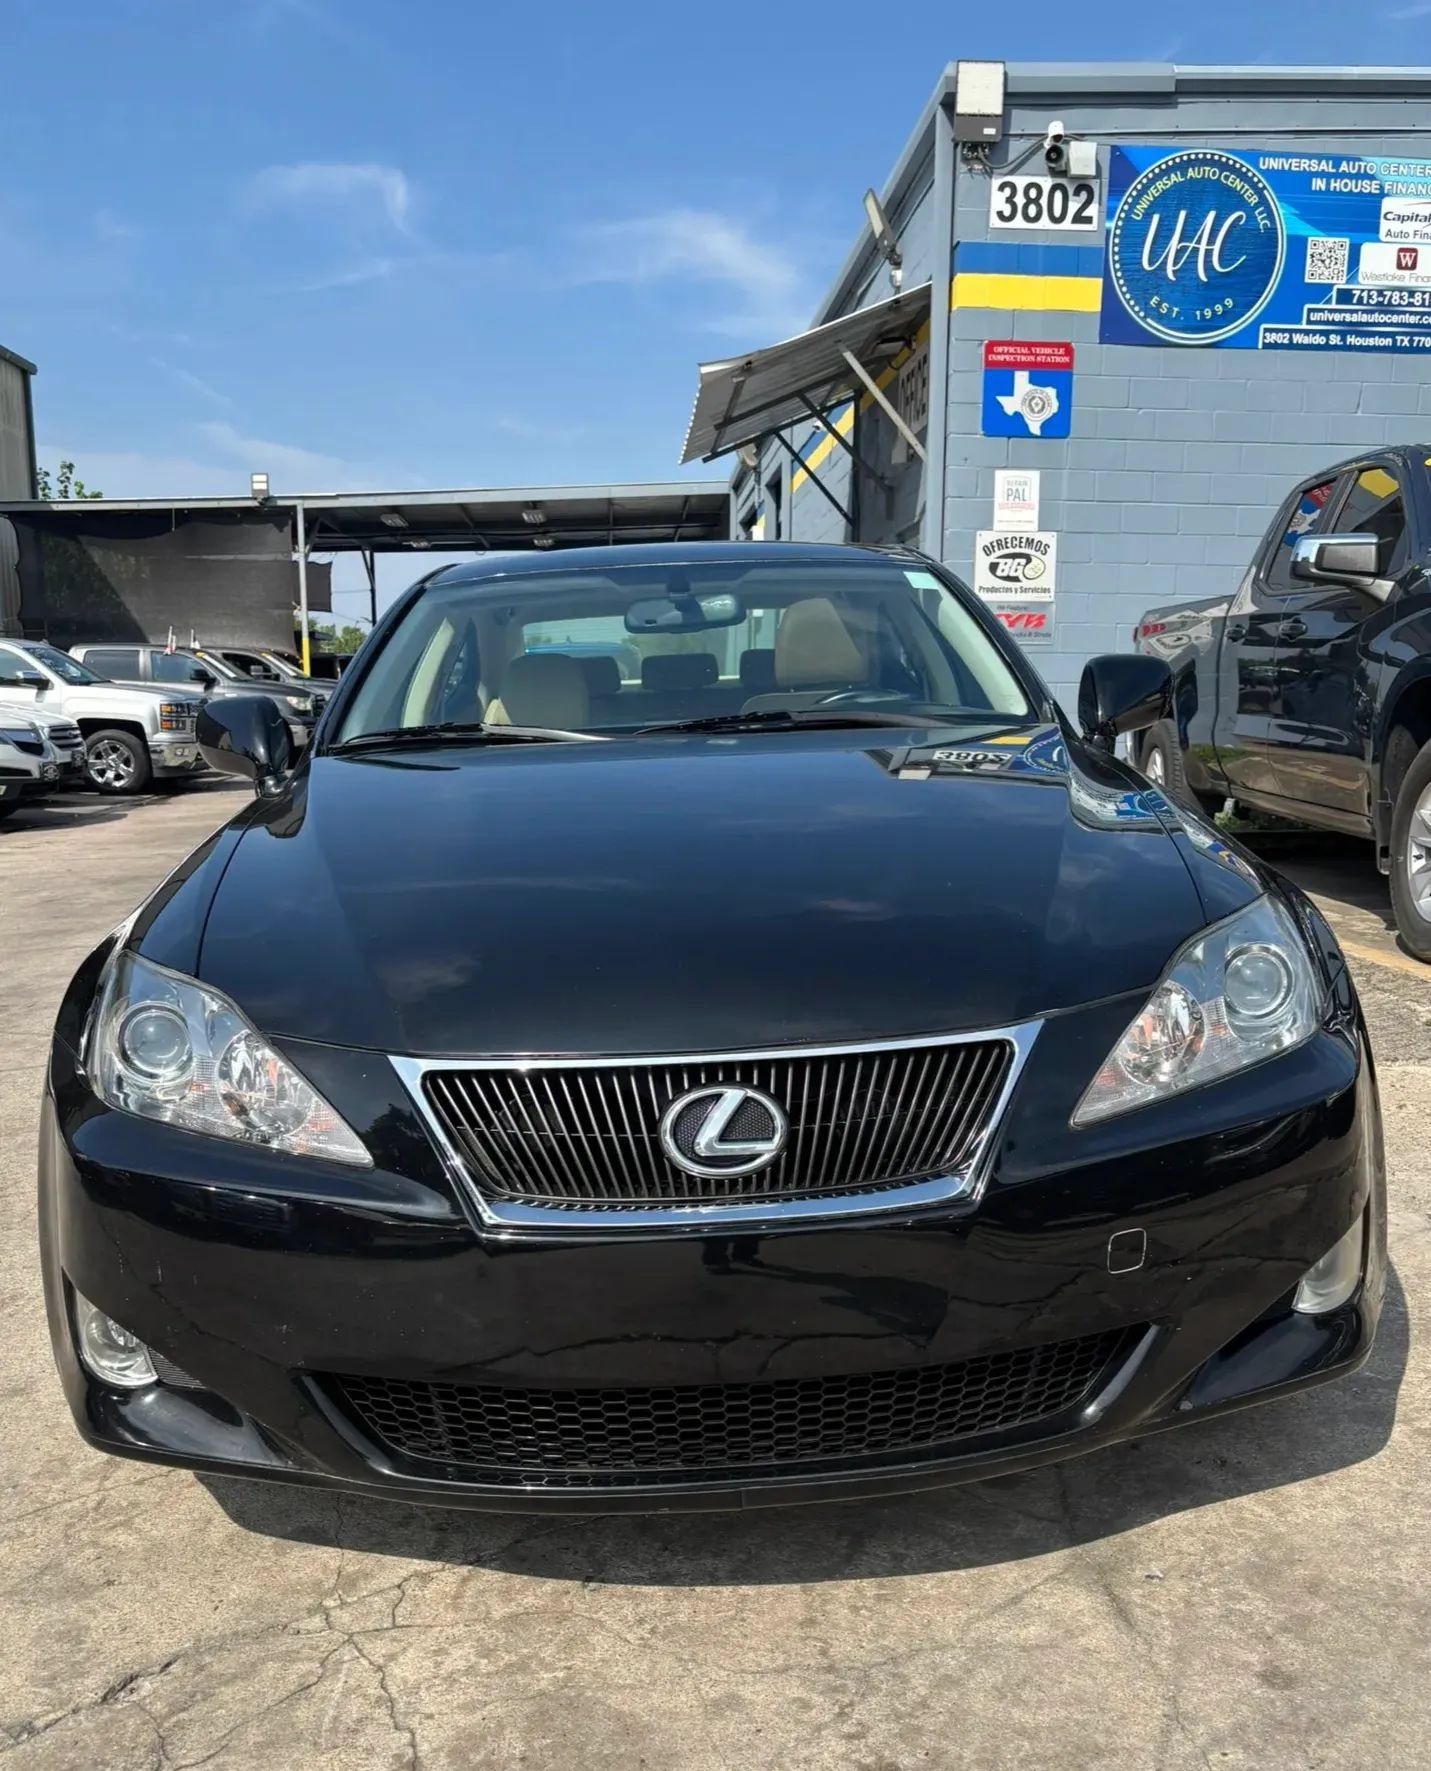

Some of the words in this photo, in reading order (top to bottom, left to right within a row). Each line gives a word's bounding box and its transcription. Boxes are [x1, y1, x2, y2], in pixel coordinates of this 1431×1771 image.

[1259, 156, 1336, 173] UNIVERSAL
[1339, 161, 1376, 175] AUTO
[1131, 171, 1185, 221] UNIVERSAL
[1187, 167, 1219, 180] AUTO
[1220, 171, 1259, 206] CENTER
[1312, 178, 1326, 191] IN
[1330, 179, 1380, 194] HOUSE
[996, 181, 1095, 225] 3802
[1385, 229, 1410, 239] Auto
[1142, 210, 1246, 282] UAC
[1361, 272, 1406, 282] Westlake
[1150, 296, 1184, 320] EST.
[1195, 298, 1233, 320] 1999
[1264, 332, 1289, 344] 3802
[1292, 334, 1326, 345] Waldo
[1329, 334, 1343, 345] St.
[1347, 335, 1392, 347] Houston
[1395, 336, 1410, 347] TX
[988, 354, 1035, 362] INSPECTION
[1036, 355, 1070, 363] STATION
[993, 346, 1030, 354] OFFICIAL
[1031, 347, 1065, 355] VEHICLE
[1006, 488, 1027, 501] PAL
[982, 536, 1050, 557] OFRECEMOS
[995, 558, 1027, 577] BG
[979, 586, 1013, 594] Productos
[1019, 586, 1051, 594] Servicios
